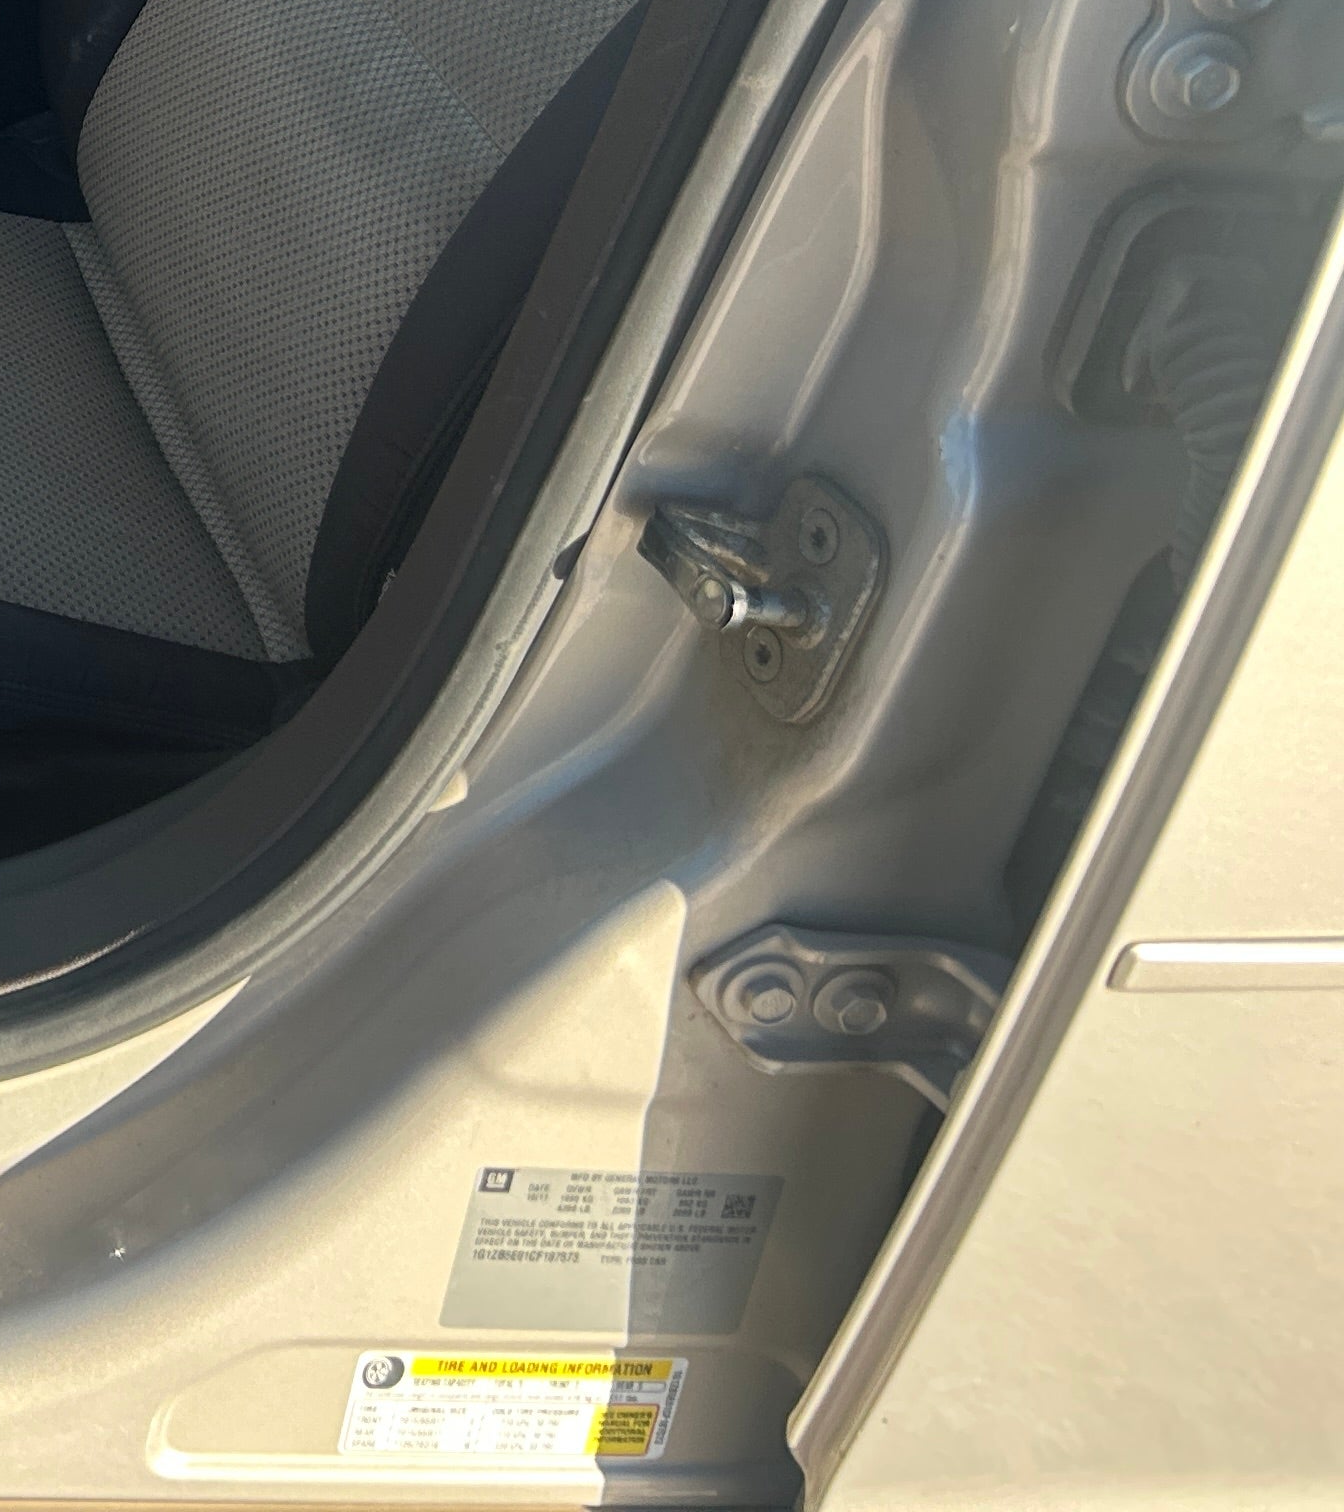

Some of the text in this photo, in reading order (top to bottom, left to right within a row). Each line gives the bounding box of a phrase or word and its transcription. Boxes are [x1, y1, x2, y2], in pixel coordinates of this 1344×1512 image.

[437, 1360, 653, 1376] TIRE AND LOADING INFORMATION
